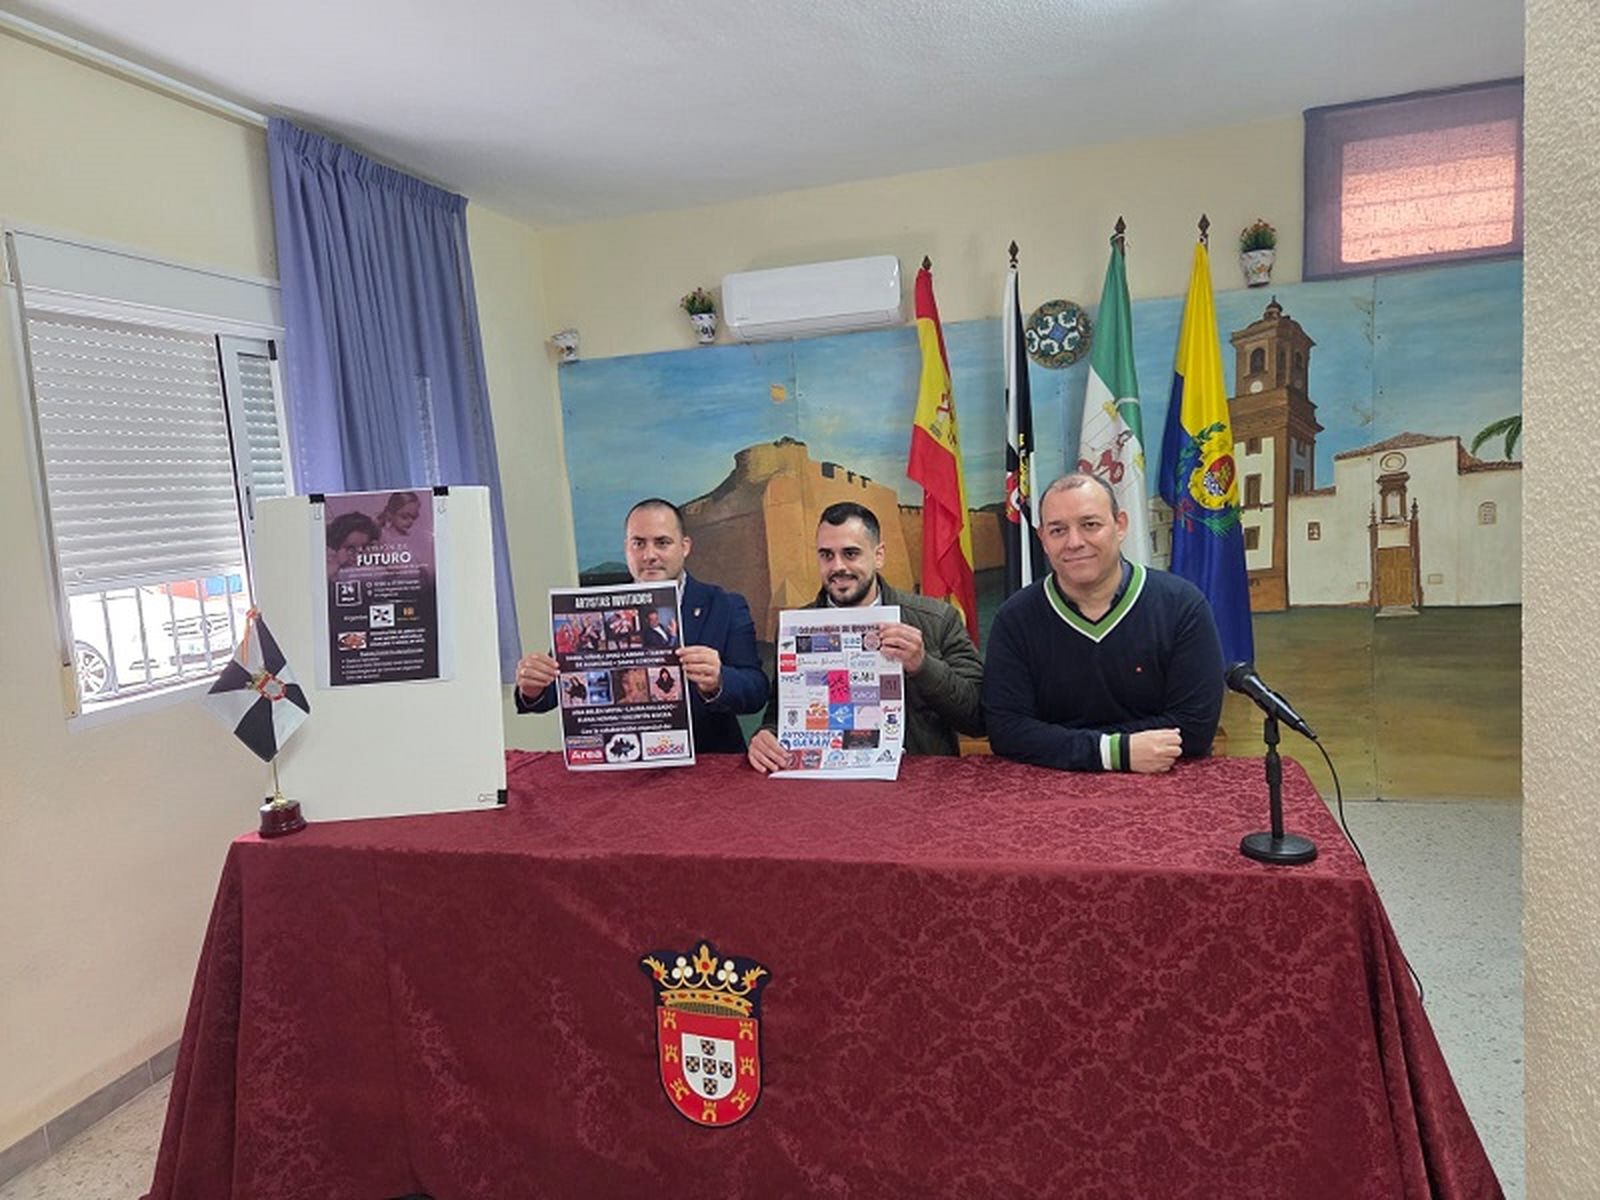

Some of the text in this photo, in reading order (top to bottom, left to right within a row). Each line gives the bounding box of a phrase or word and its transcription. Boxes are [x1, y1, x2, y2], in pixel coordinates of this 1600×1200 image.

[357, 551, 411, 566] FUTURO
[575, 592, 653, 608] ARTISTAS INVITADOS
